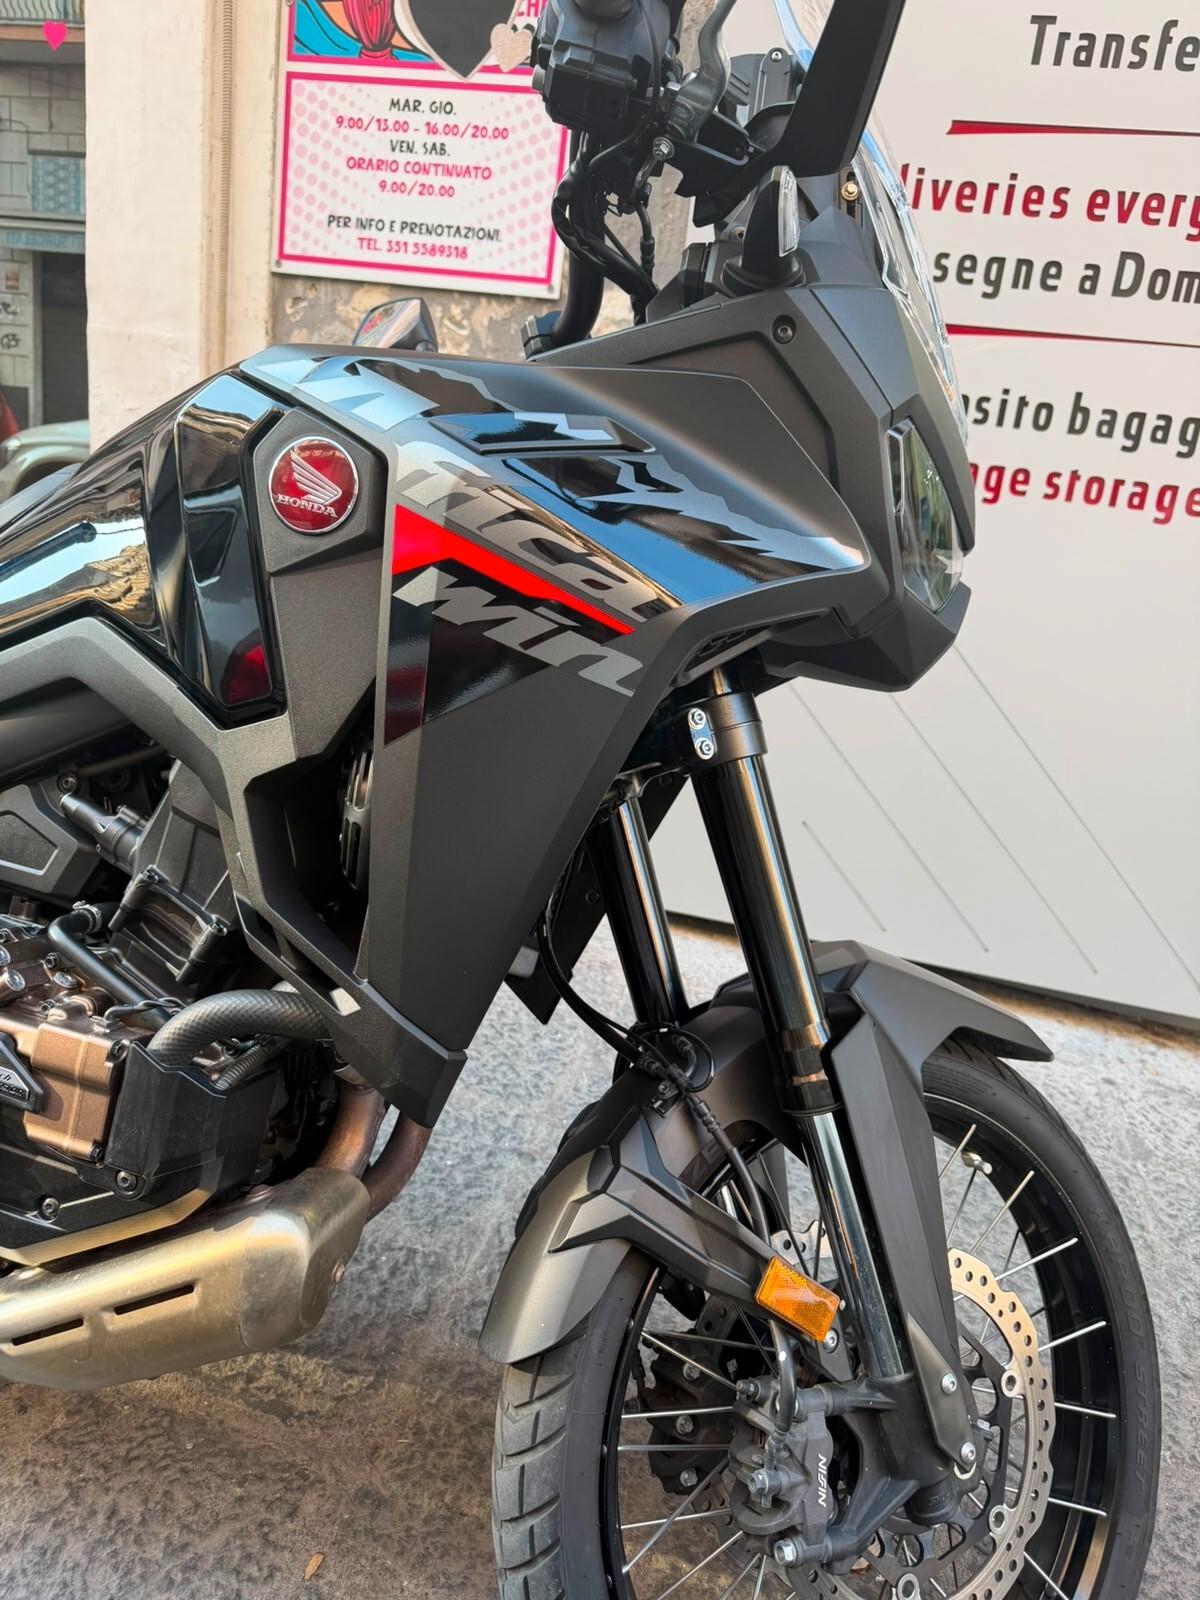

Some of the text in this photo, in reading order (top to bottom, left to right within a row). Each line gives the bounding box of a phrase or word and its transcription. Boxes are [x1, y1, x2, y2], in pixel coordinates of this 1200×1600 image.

[1030, 15, 1200, 72] Transfe
[389, 98, 457, 115] MAR. GIO.
[336, 115, 409, 133] 9.00/13.00
[425, 121, 509, 140] 16.00/20.00
[390, 139, 450, 157] VEN. SAB.
[346, 156, 492, 181] ORARIO CONTINUATO
[379, 180, 455, 198] 9.00/20.00
[327, 215, 351, 229] PER
[356, 217, 385, 232] INFO
[389, 220, 396, 233] E
[387, 240, 408, 254] 351
[933, 251, 1063, 299] segne
[1078, 263, 1101, 295] a
[276, 493, 338, 519] HONDA
[1042, 469, 1200, 525] storage
